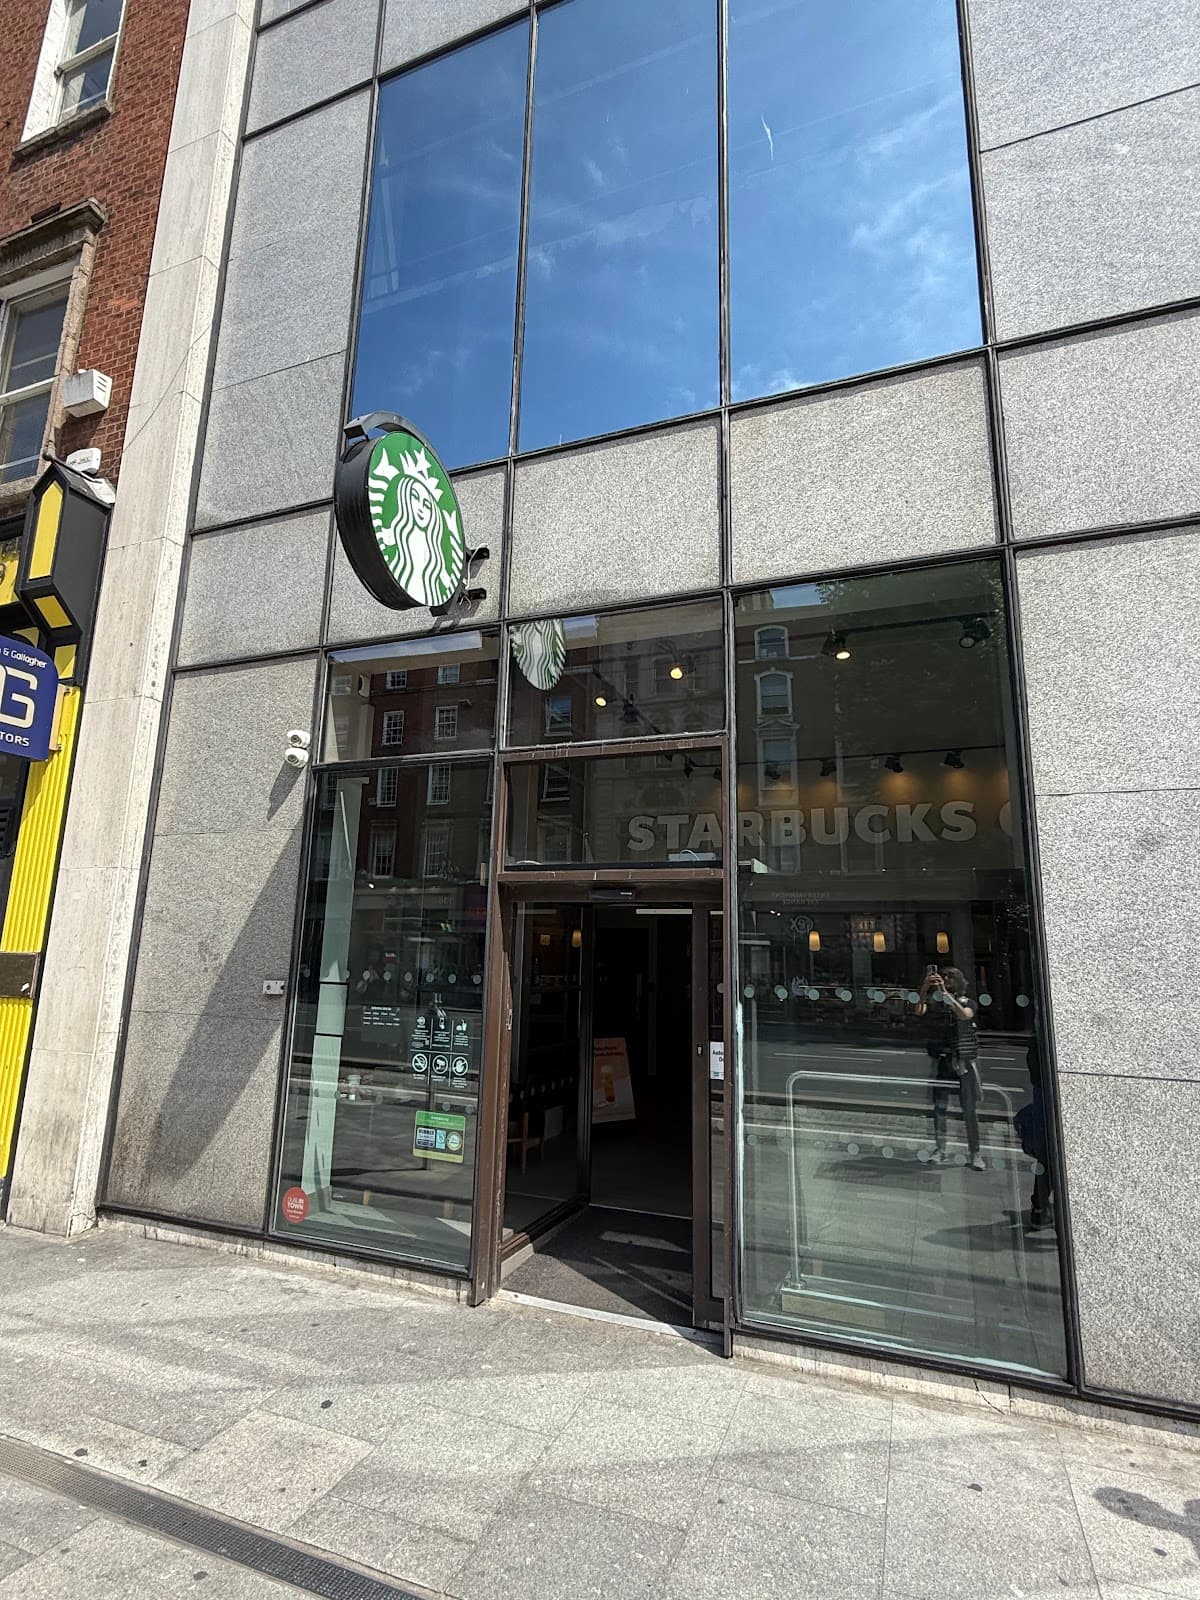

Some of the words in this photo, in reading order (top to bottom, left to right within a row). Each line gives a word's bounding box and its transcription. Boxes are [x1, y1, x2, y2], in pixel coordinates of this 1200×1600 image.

[3, 648, 10, 656] &
[11, 650, 48, 668] Gallagher
[627, 801, 977, 851] STARBUCKS
